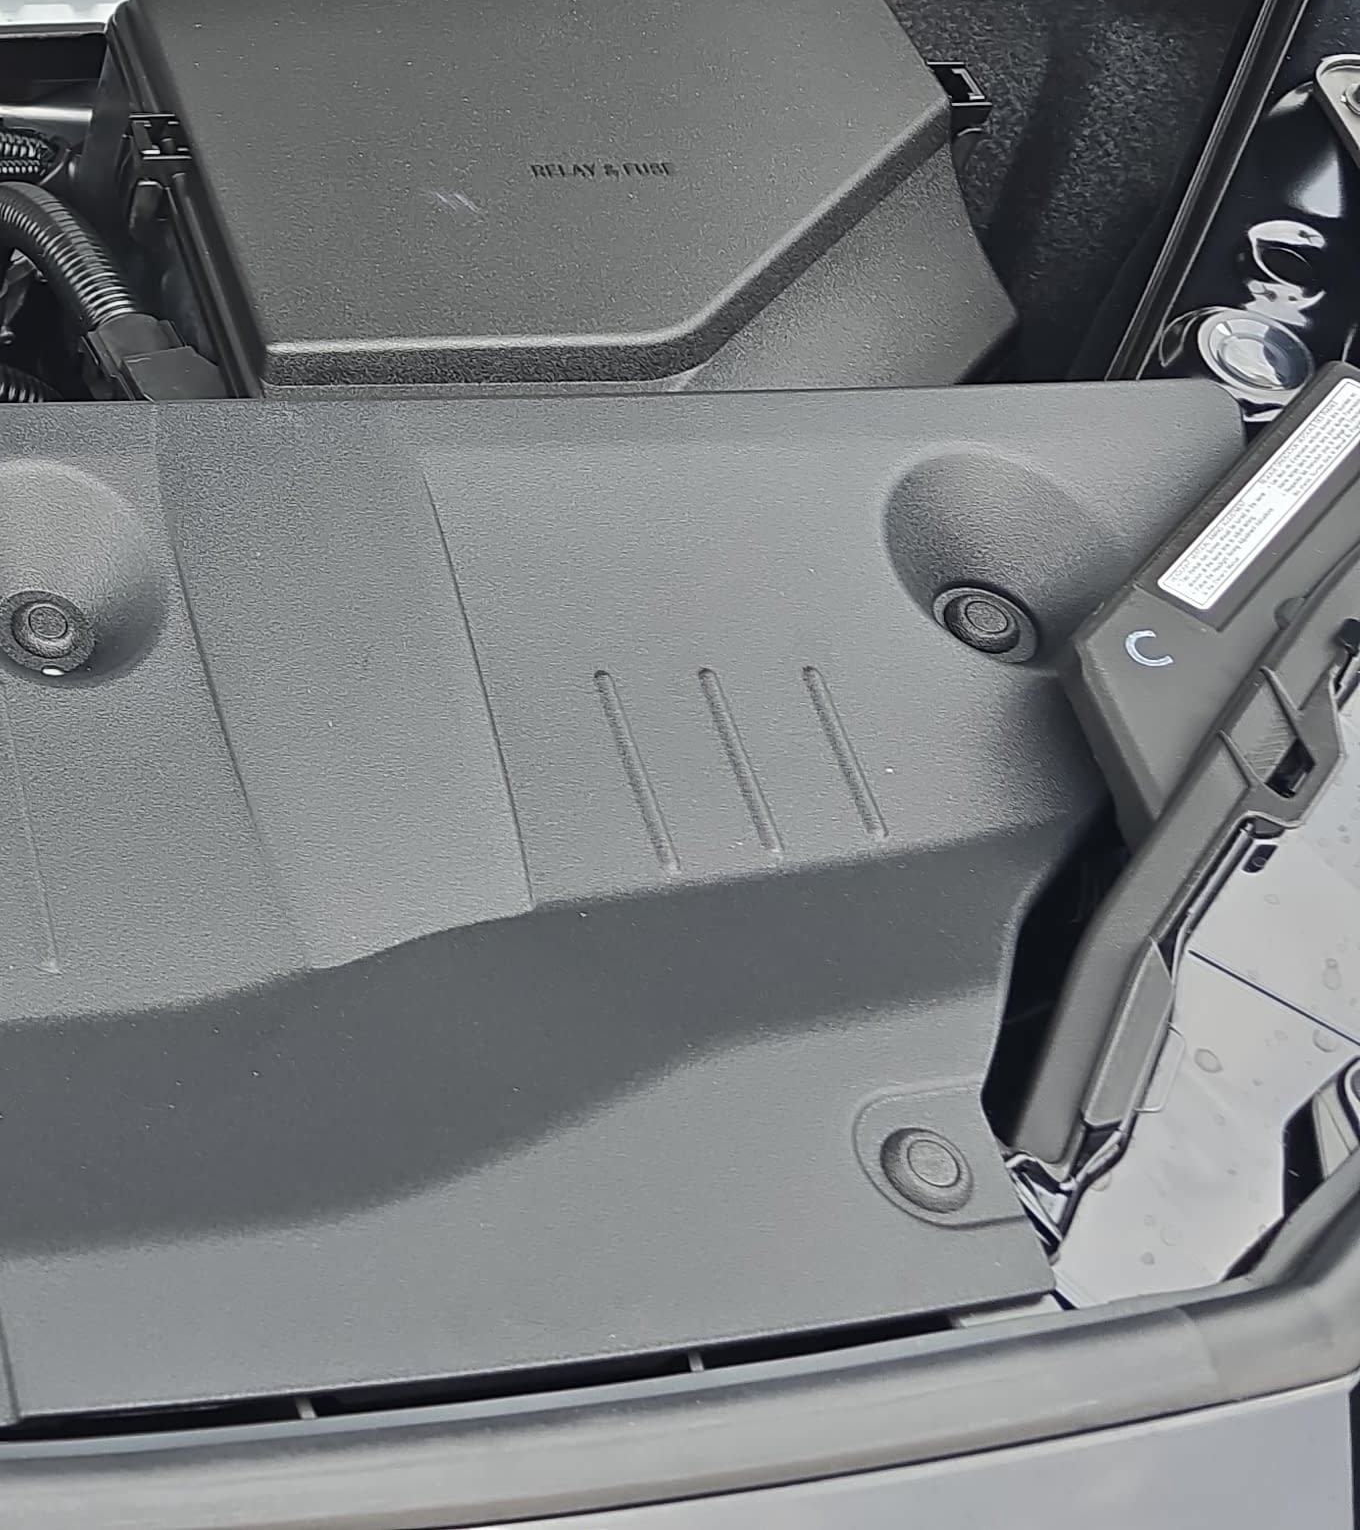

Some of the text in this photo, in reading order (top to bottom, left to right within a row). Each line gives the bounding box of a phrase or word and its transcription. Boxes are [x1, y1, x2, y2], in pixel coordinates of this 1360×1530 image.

[530, 161, 676, 180] RELAY & FUSE
